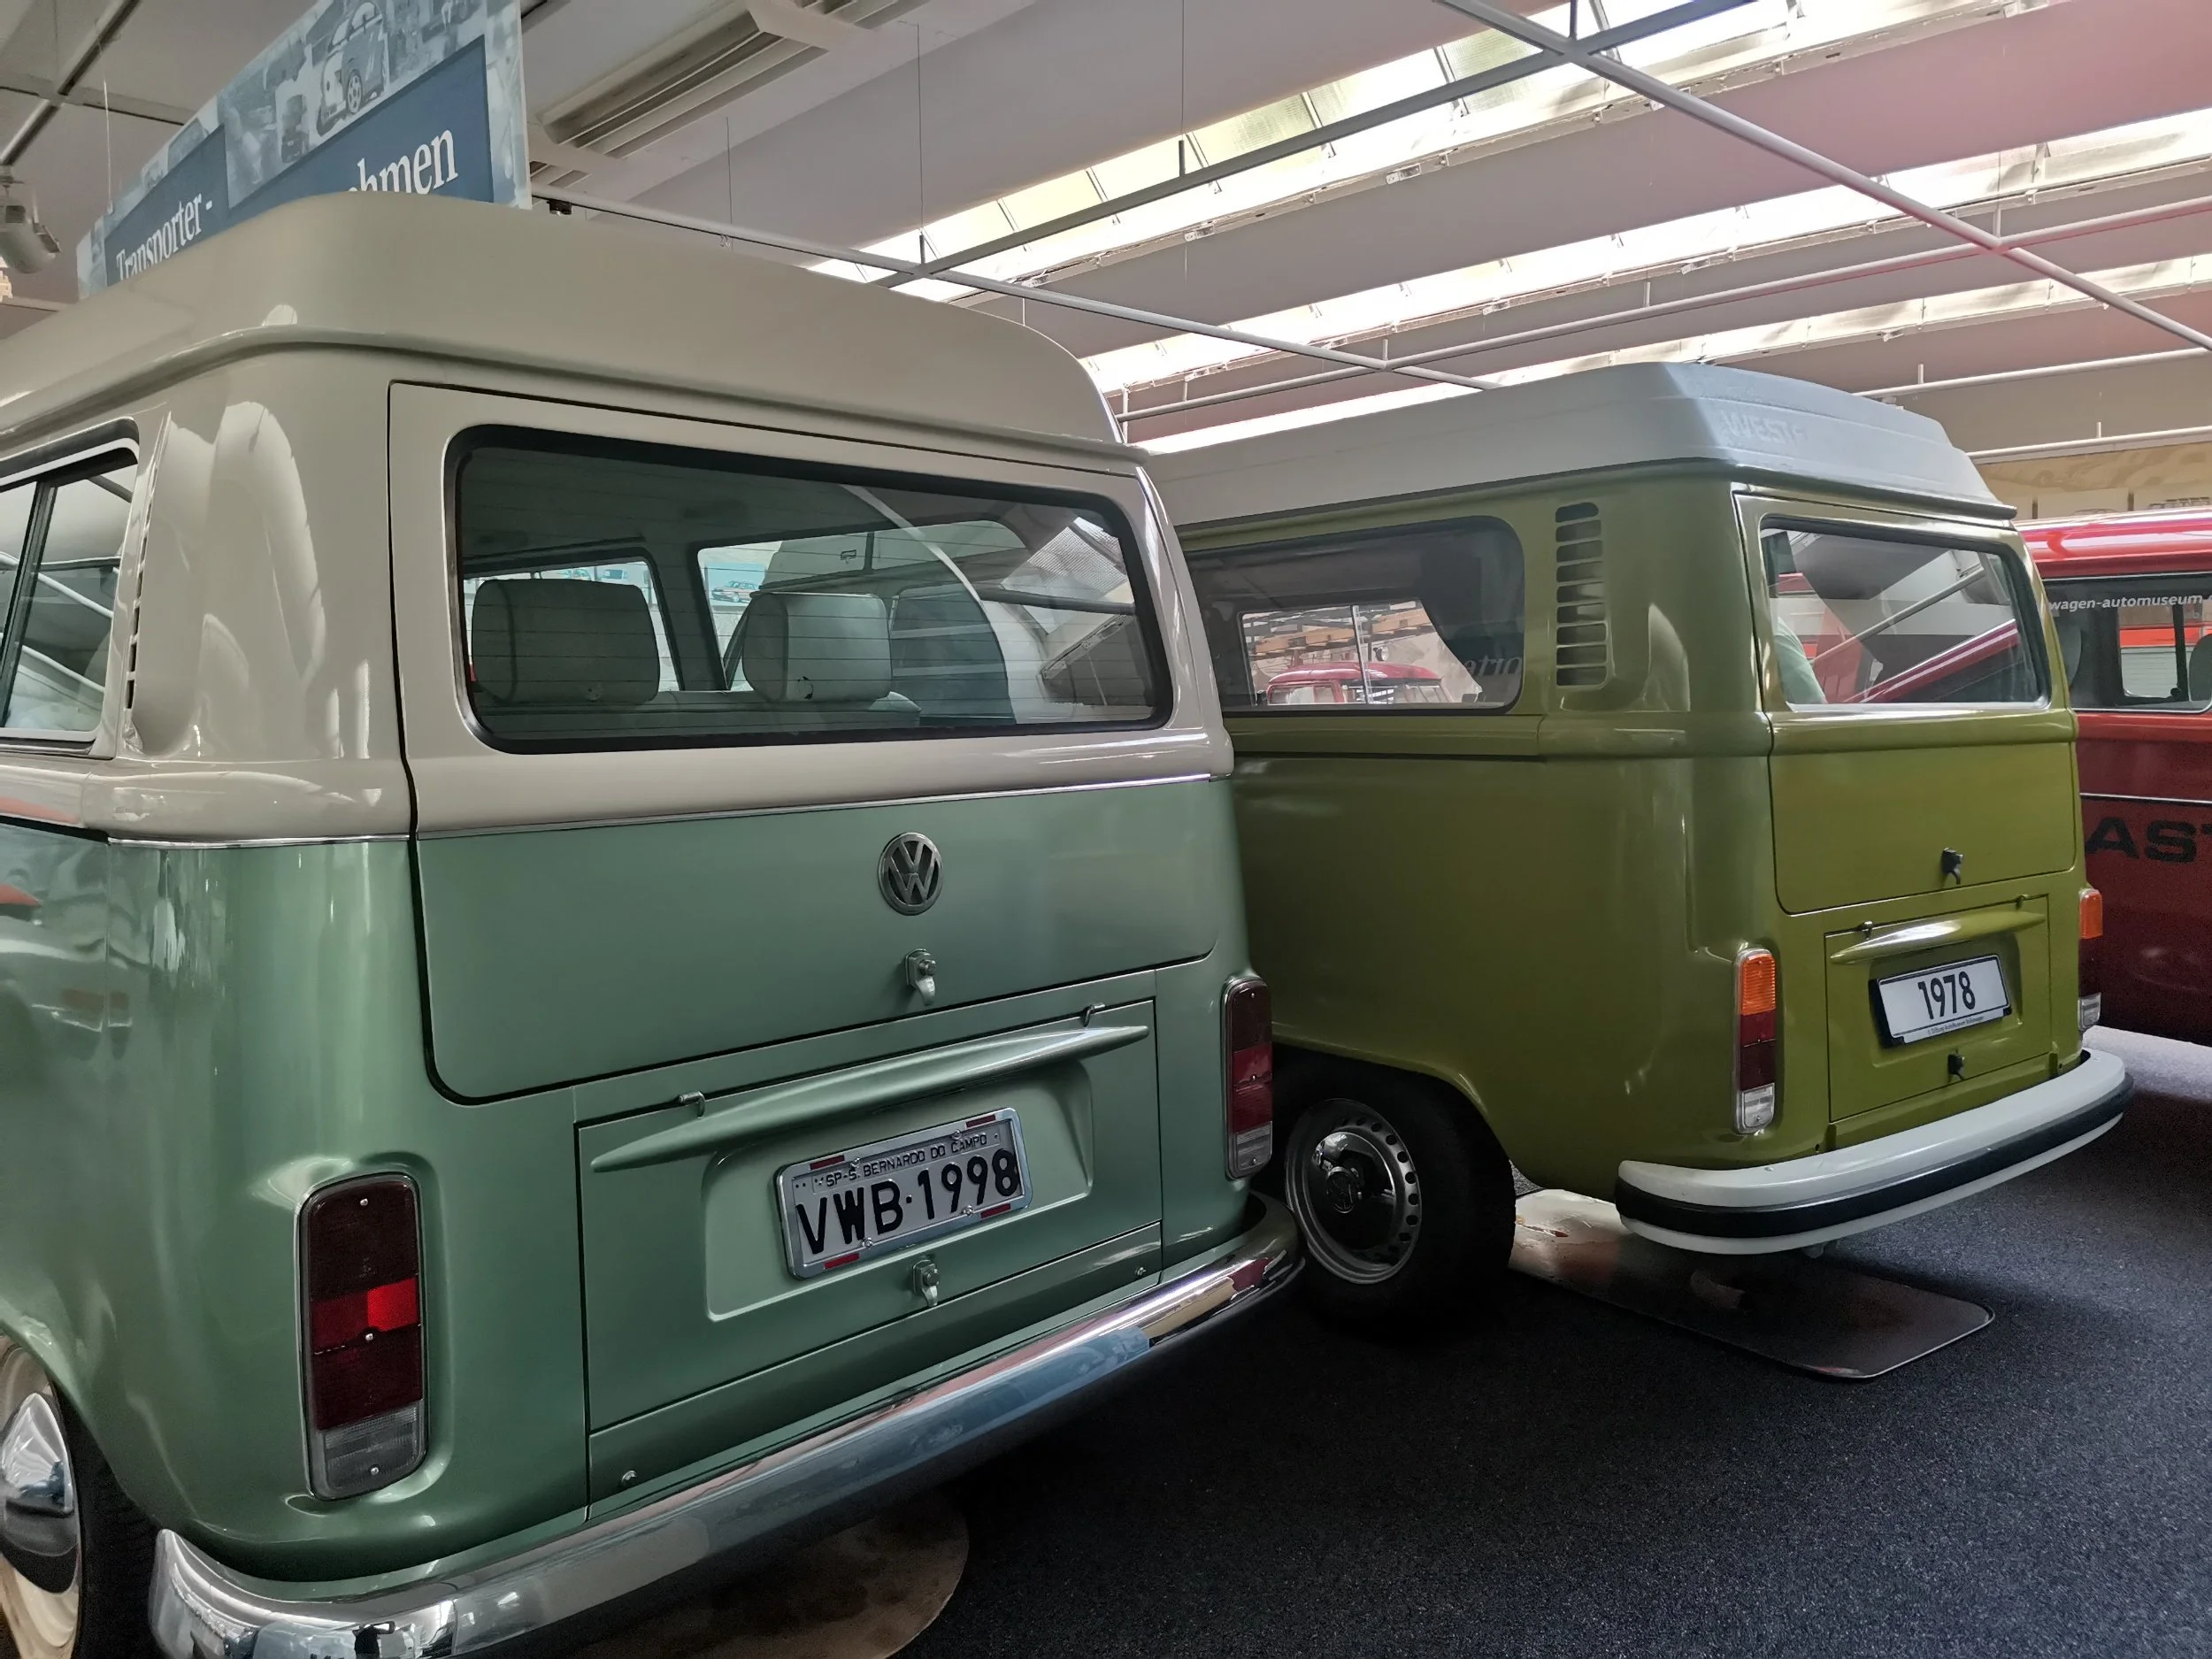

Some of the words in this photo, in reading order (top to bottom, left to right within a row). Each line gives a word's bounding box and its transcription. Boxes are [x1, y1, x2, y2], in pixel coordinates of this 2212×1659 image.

[884, 836, 940, 909] VW
[1917, 971, 1976, 1019] 1978
[863, 1149, 926, 1177] BERNARDO
[930, 1145, 946, 1159] DO
[950, 1133, 987, 1154] CAMPO
